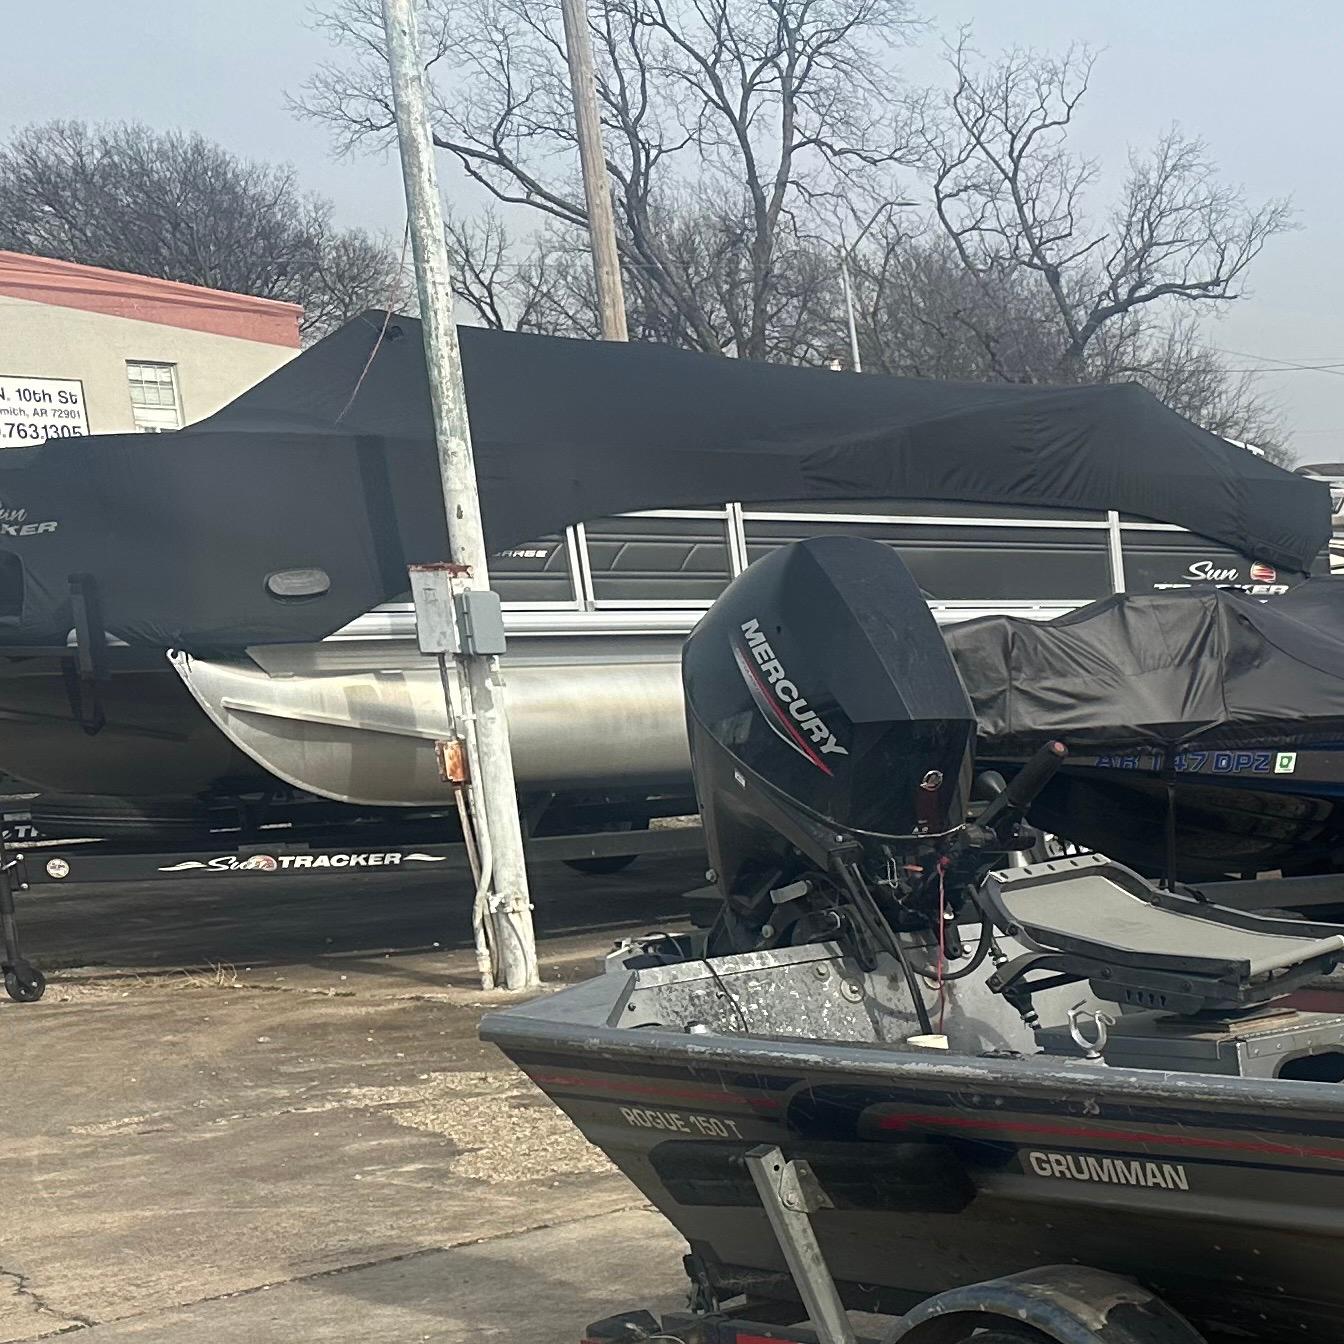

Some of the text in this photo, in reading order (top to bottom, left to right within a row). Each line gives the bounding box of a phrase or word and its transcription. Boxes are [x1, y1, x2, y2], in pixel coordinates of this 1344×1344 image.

[16, 388, 52, 403] 10th
[58, 390, 78, 405] St
[33, 408, 49, 418] AR
[51, 409, 81, 419] 72901
[0, 422, 83, 440] .763.1305
[1181, 560, 1239, 581] Sun
[741, 618, 849, 755] MERCURY
[277, 852, 402, 869] TRACKER
[620, 1106, 743, 1139] ROGUE 150 T
[1029, 1151, 1190, 1191] GRUMMAN
